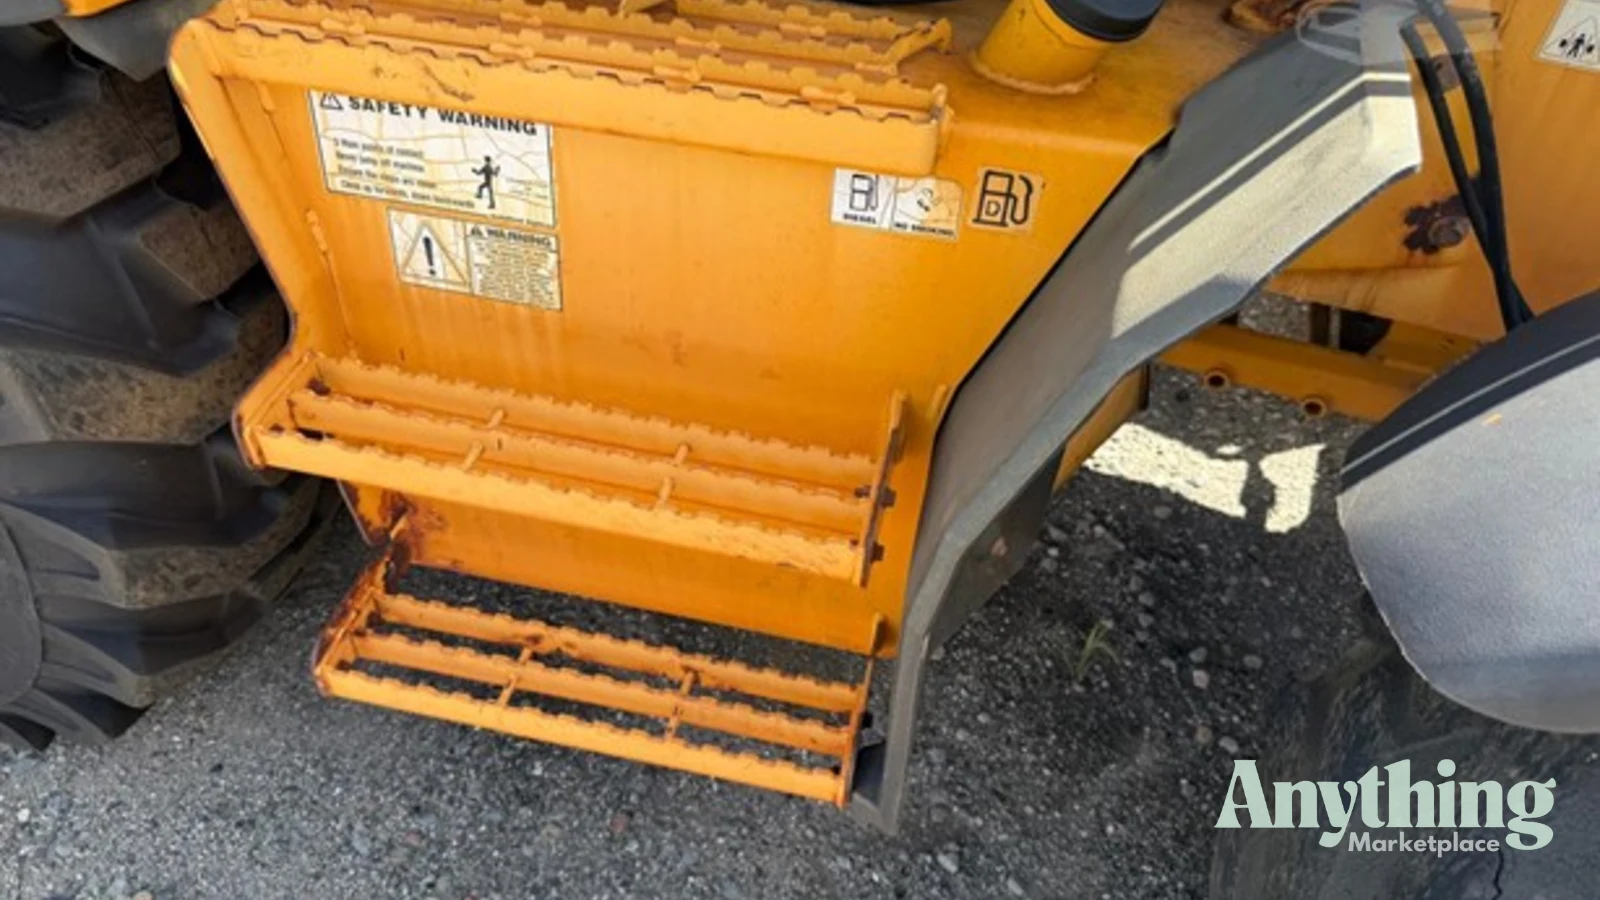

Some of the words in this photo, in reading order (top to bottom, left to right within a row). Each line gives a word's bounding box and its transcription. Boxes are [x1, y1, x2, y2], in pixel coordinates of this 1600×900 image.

[348, 95, 429, 119] SAFETY
[437, 109, 538, 136] WARNING
[843, 213, 877, 224] DIESEL
[487, 228, 552, 247] WARNING
[911, 224, 955, 236] SMOKING
